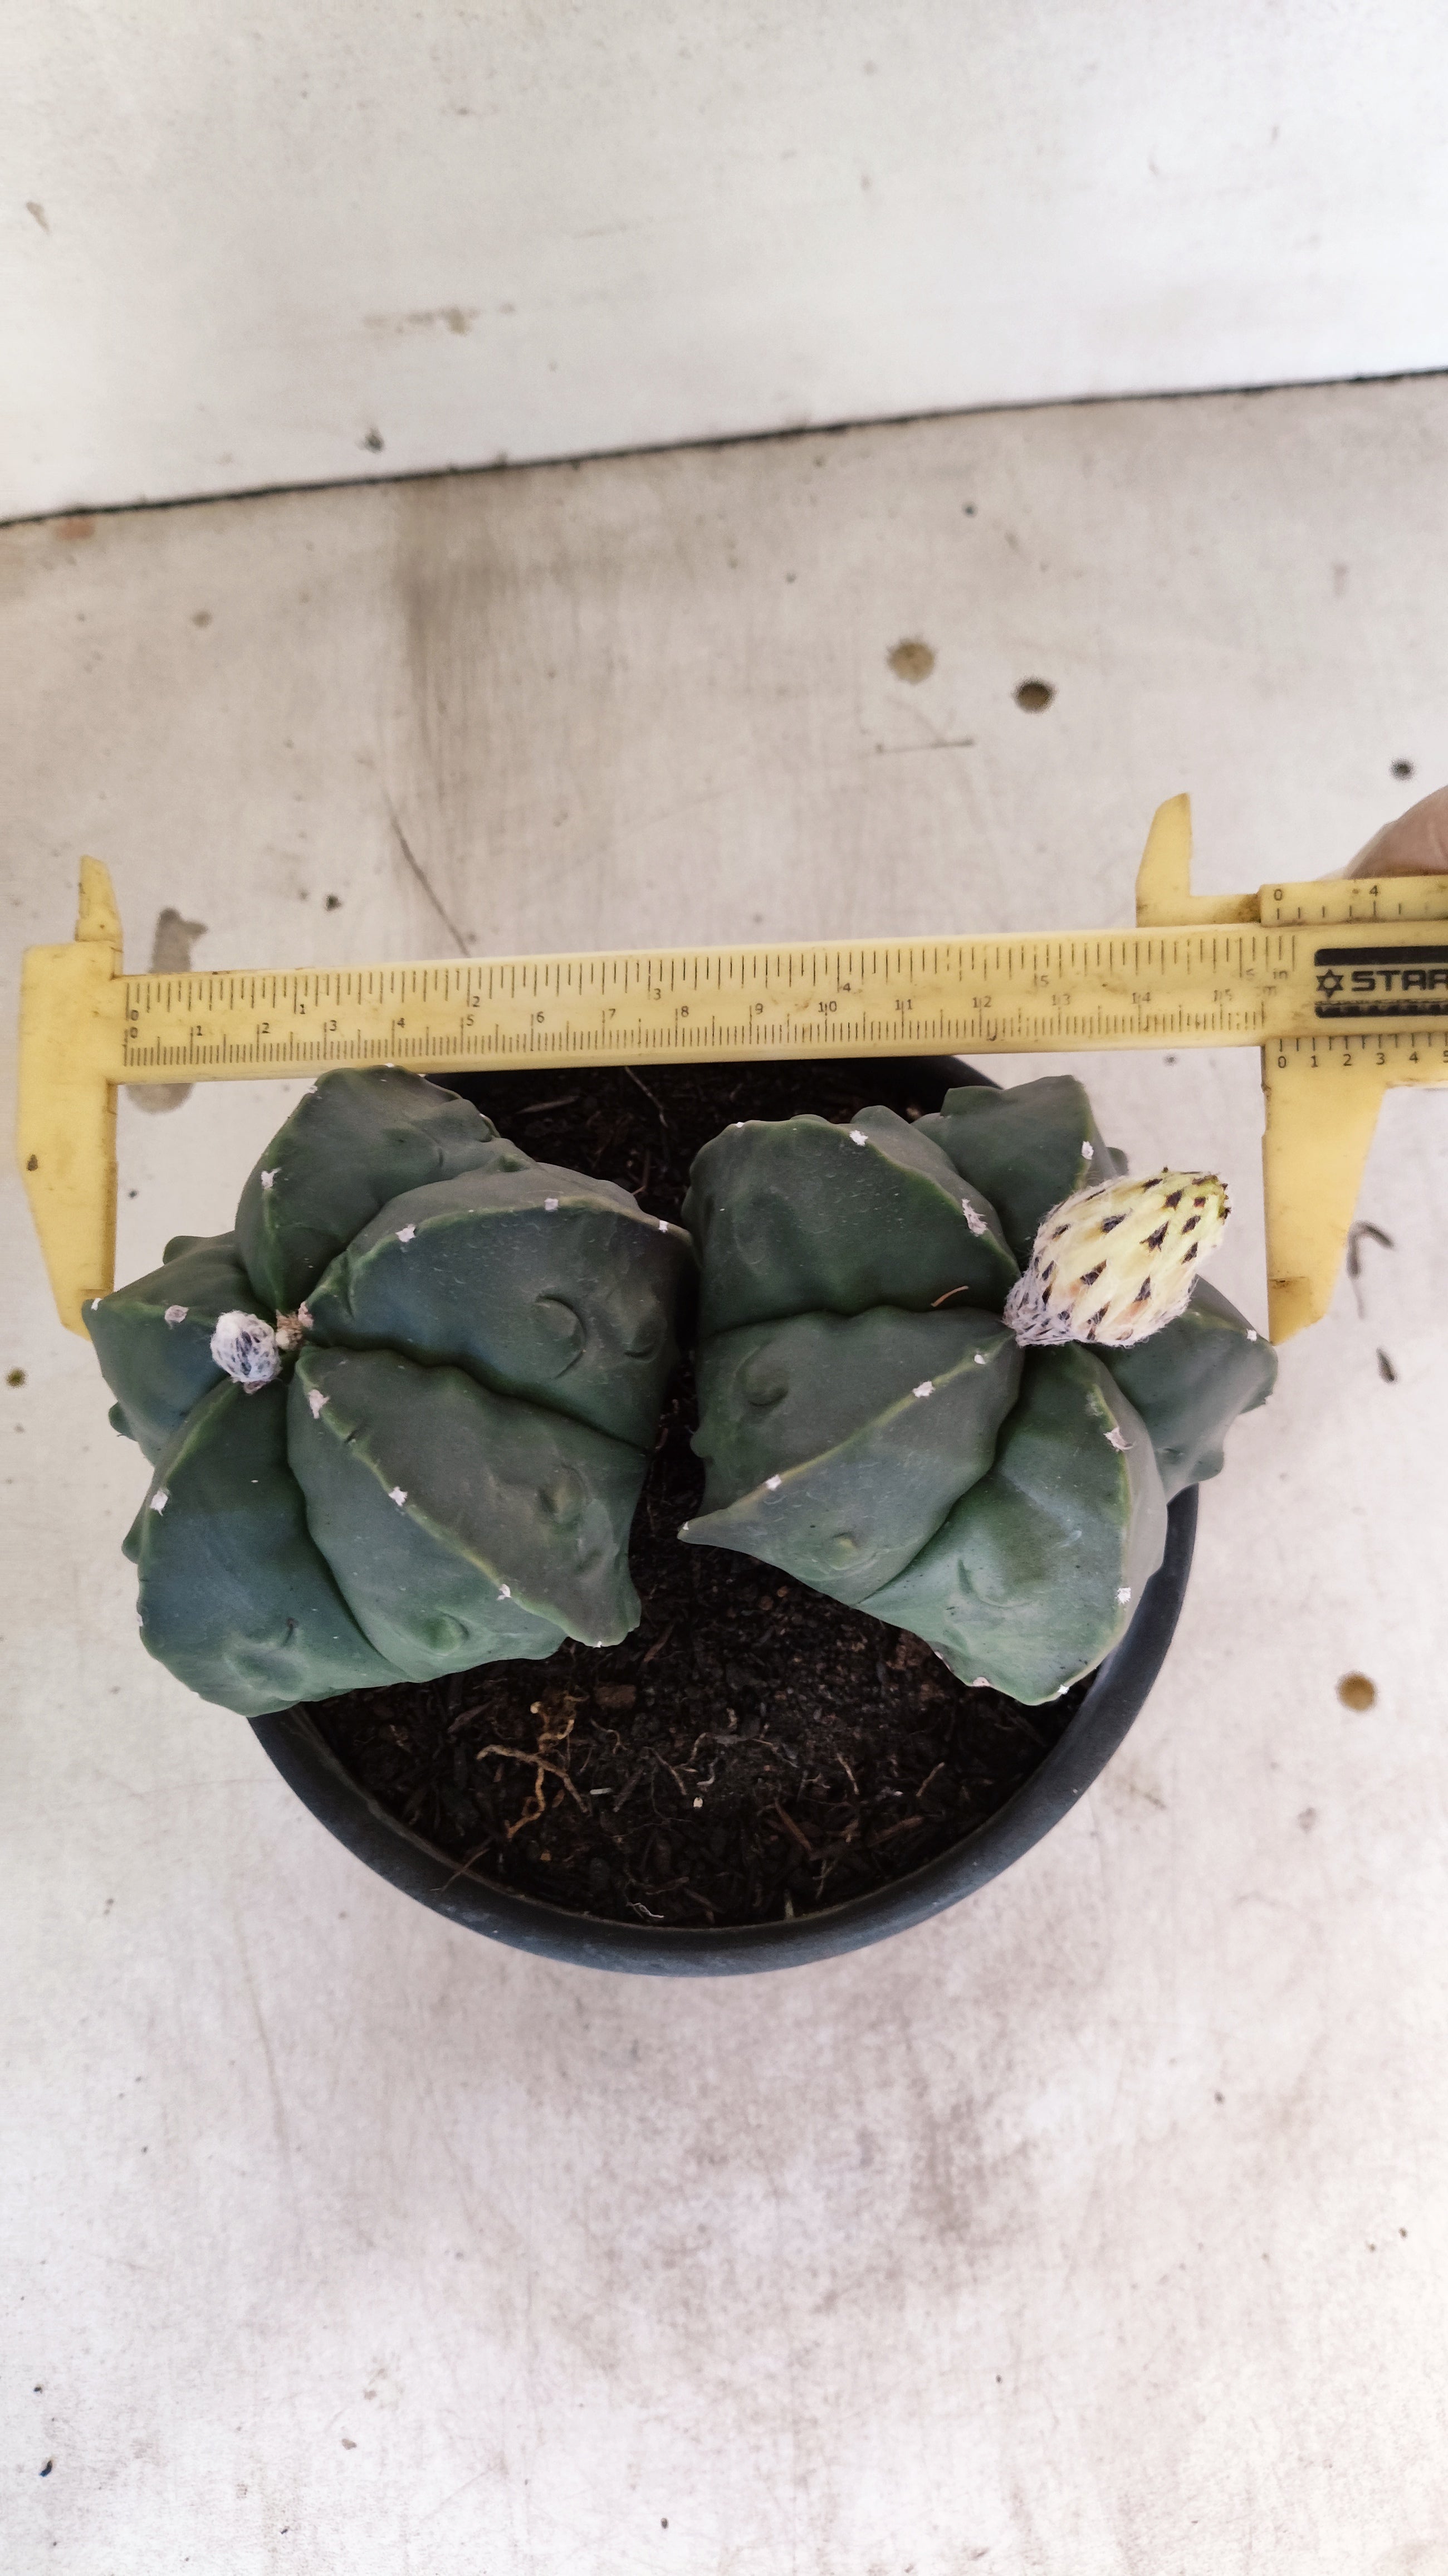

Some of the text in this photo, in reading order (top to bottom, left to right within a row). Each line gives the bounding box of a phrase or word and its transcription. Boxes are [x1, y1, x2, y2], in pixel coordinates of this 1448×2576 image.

[1274, 885, 1379, 901] 0 4
[130, 1010, 139, 1021] 0
[300, 1004, 305, 1014] 1
[472, 997, 480, 1007] 2
[654, 989, 661, 999] 3
[843, 983, 851, 992] 4
[1040, 975, 1049, 987] 5
[130, 1027, 138, 1038] 0
[197, 1026, 202, 1036] 1
[262, 1023, 270, 1033] 2
[330, 1020, 337, 1031] 3
[398, 1017, 405, 1028] 4
[467, 1014, 474, 1026] 5
[536, 1012, 544, 1023] 6
[609, 1008, 616, 1019] 7
[681, 1006, 689, 1017] 8
[756, 1003, 764, 1014] 9
[818, 1001, 837, 1012] 10
[896, 999, 912, 1010] 11
[972, 996, 992, 1008] 12
[1051, 993, 1070, 1006] 13
[1278, 1056, 1286, 1069] 0
[1310, 1055, 1318, 1067] 1
[1343, 1054, 1352, 1066] 2
[1376, 1052, 1385, 1065] 3
[1409, 1051, 1418, 1063] 4
